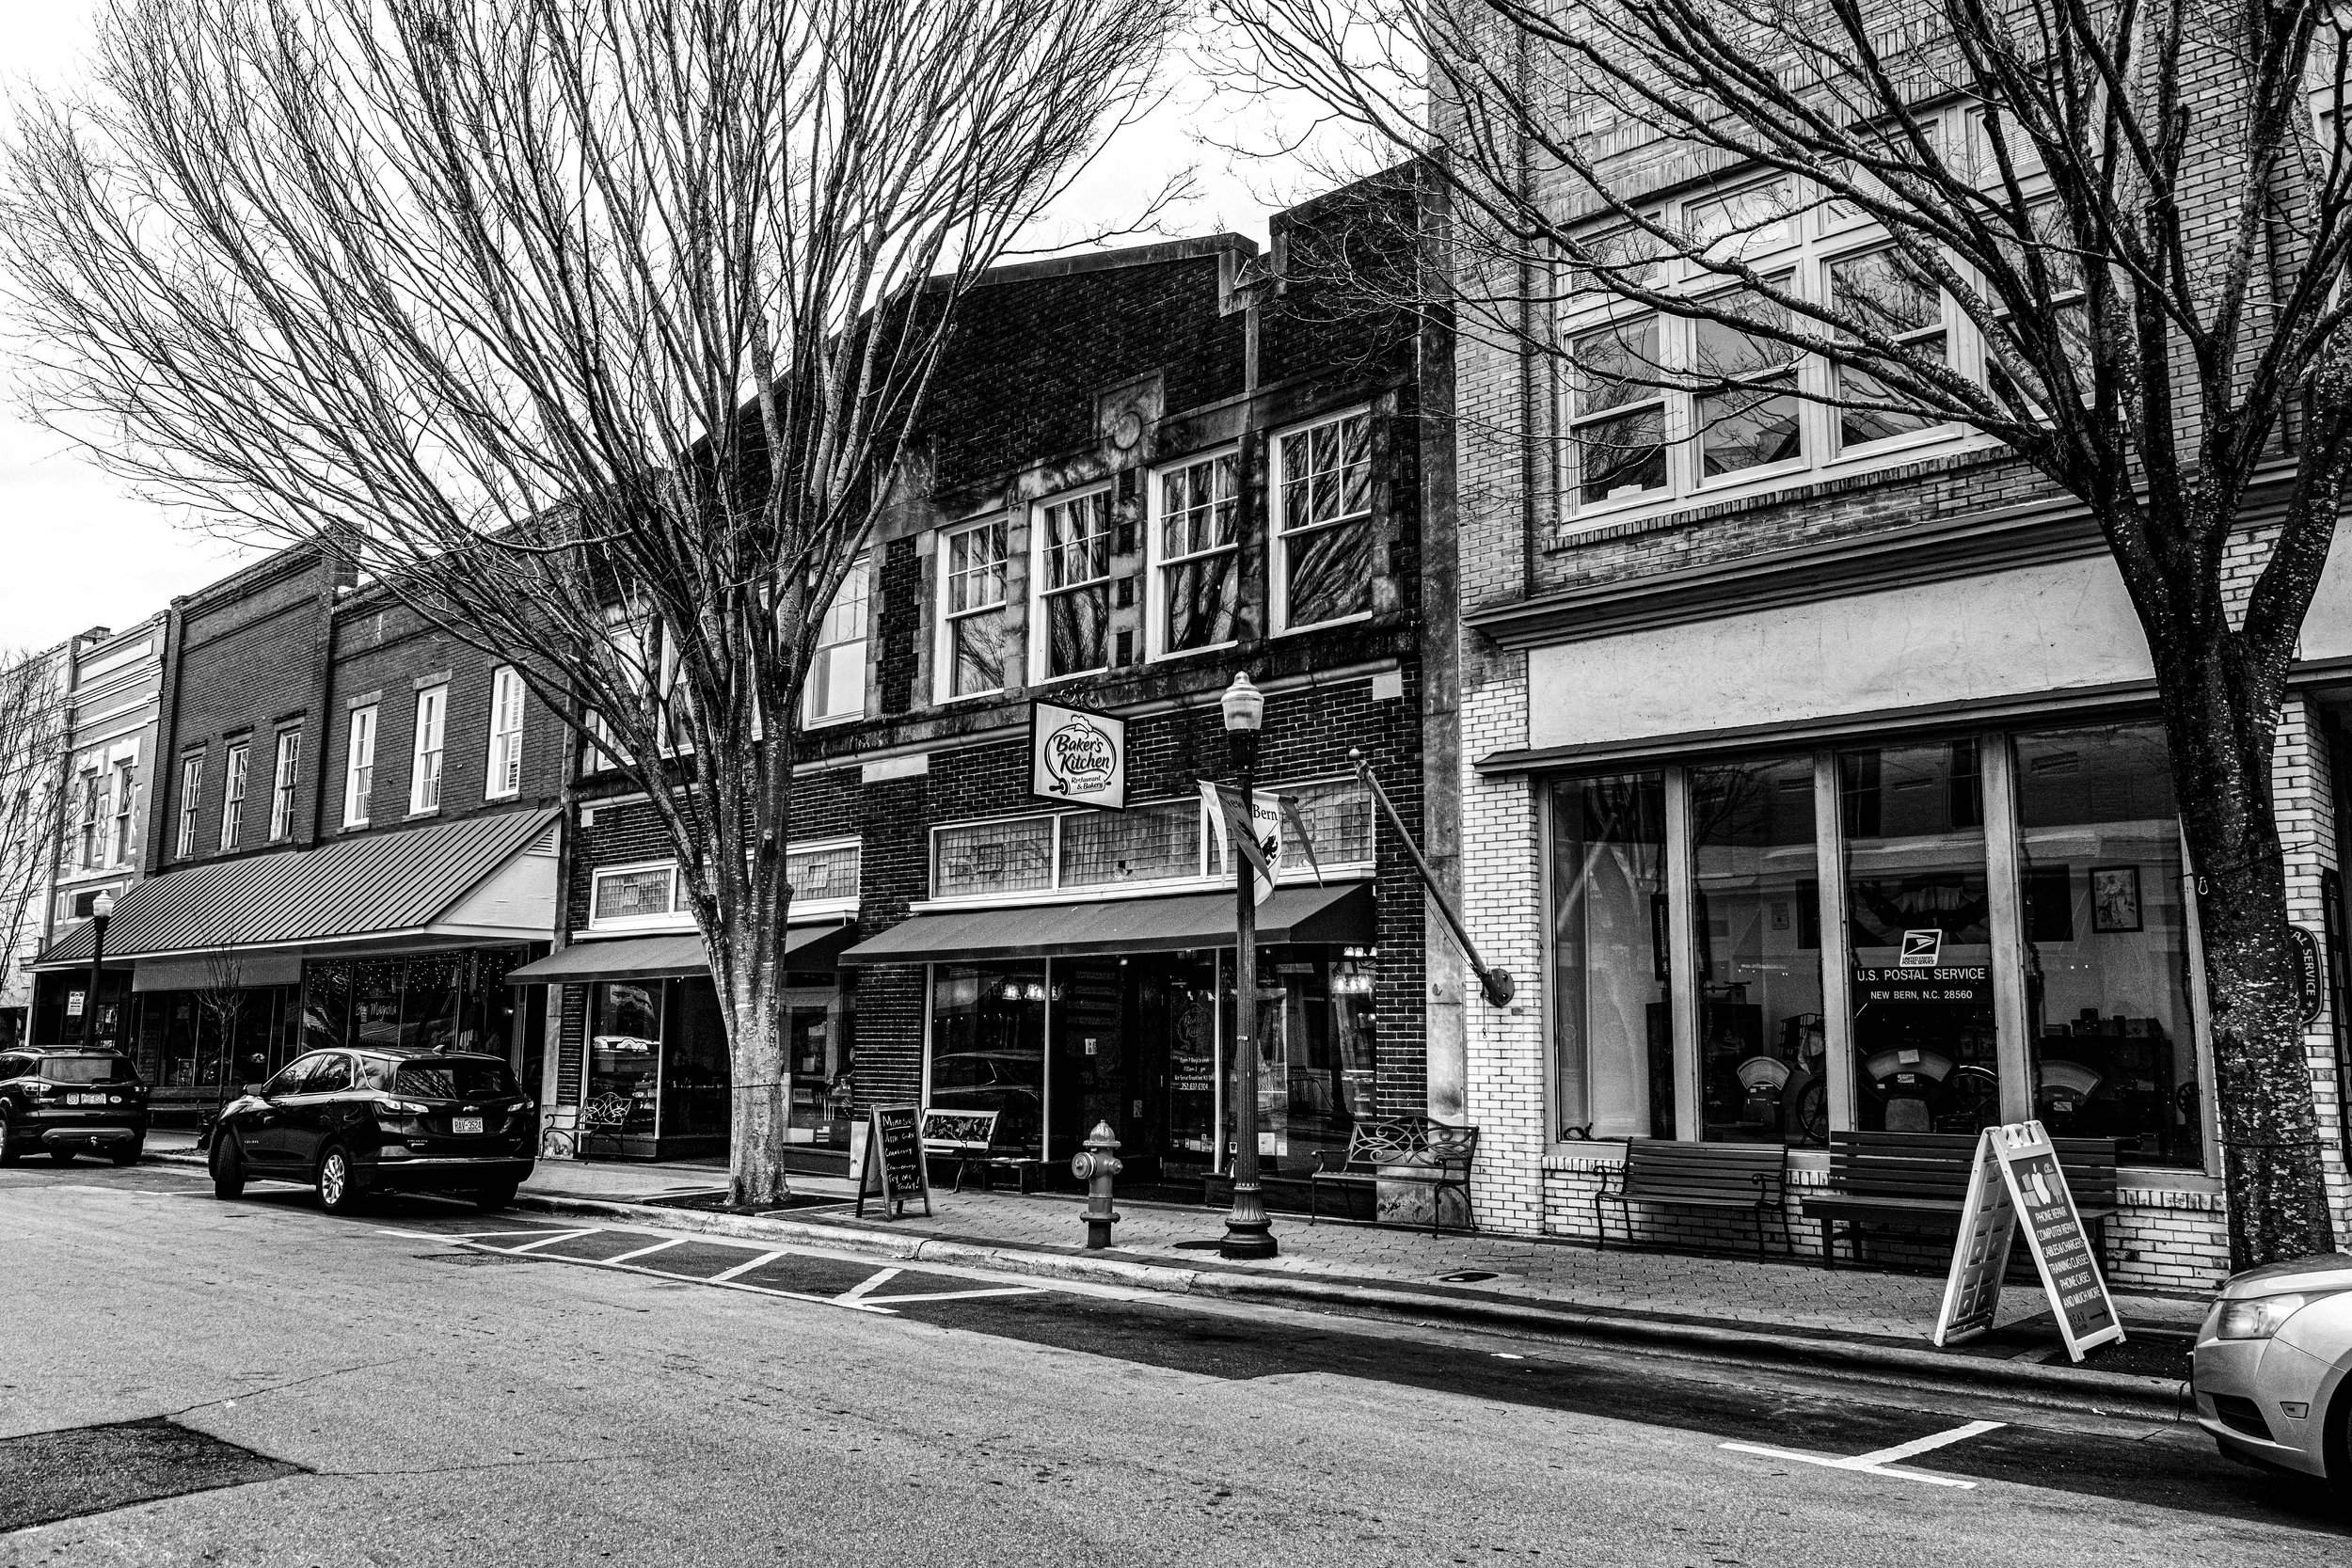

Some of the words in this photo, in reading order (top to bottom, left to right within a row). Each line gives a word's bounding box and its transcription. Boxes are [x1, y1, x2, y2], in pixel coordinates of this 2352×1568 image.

[1053, 734, 1104, 753] Baker's
[1057, 752, 1109, 775] Kitchen
[1072, 775, 1101, 784] Restaurant
[1083, 782, 1103, 790] Bakery
[1252, 803, 1279, 820] Bern
[1857, 970, 1879, 981] U.S.
[1883, 969, 1929, 981] POSTAL
[1933, 968, 1985, 980] SERVICE
[2302, 948, 2316, 996] SERVICE
[1870, 990, 1890, 1000] NEW
[1893, 990, 1919, 1001] BERN,
[1922, 990, 1940, 999] N.C.
[1944, 990, 1973, 999] 28560
[888, 1174, 898, 1184] Try
[2035, 1209, 2053, 1223] PHONE
[2051, 1206, 2068, 1219] REPAIR
[2037, 1225, 2061, 1241] COMPUTER
[2060, 1221, 2078, 1234] REPAIR
[2042, 1243, 2060, 1258] CABLES
[2062, 1237, 2084, 1252] CHARGERS
[2048, 1259, 2072, 1275] TRAINING
[2070, 1253, 2090, 1268] CLASSES
[2059, 1275, 2077, 1291] PHONE
[2075, 1271, 2090, 1285] CASES
[2063, 1295, 2074, 1308] AND
[2073, 1290, 2089, 1305] MUCH
[2088, 1286, 2102, 1300] MORE
